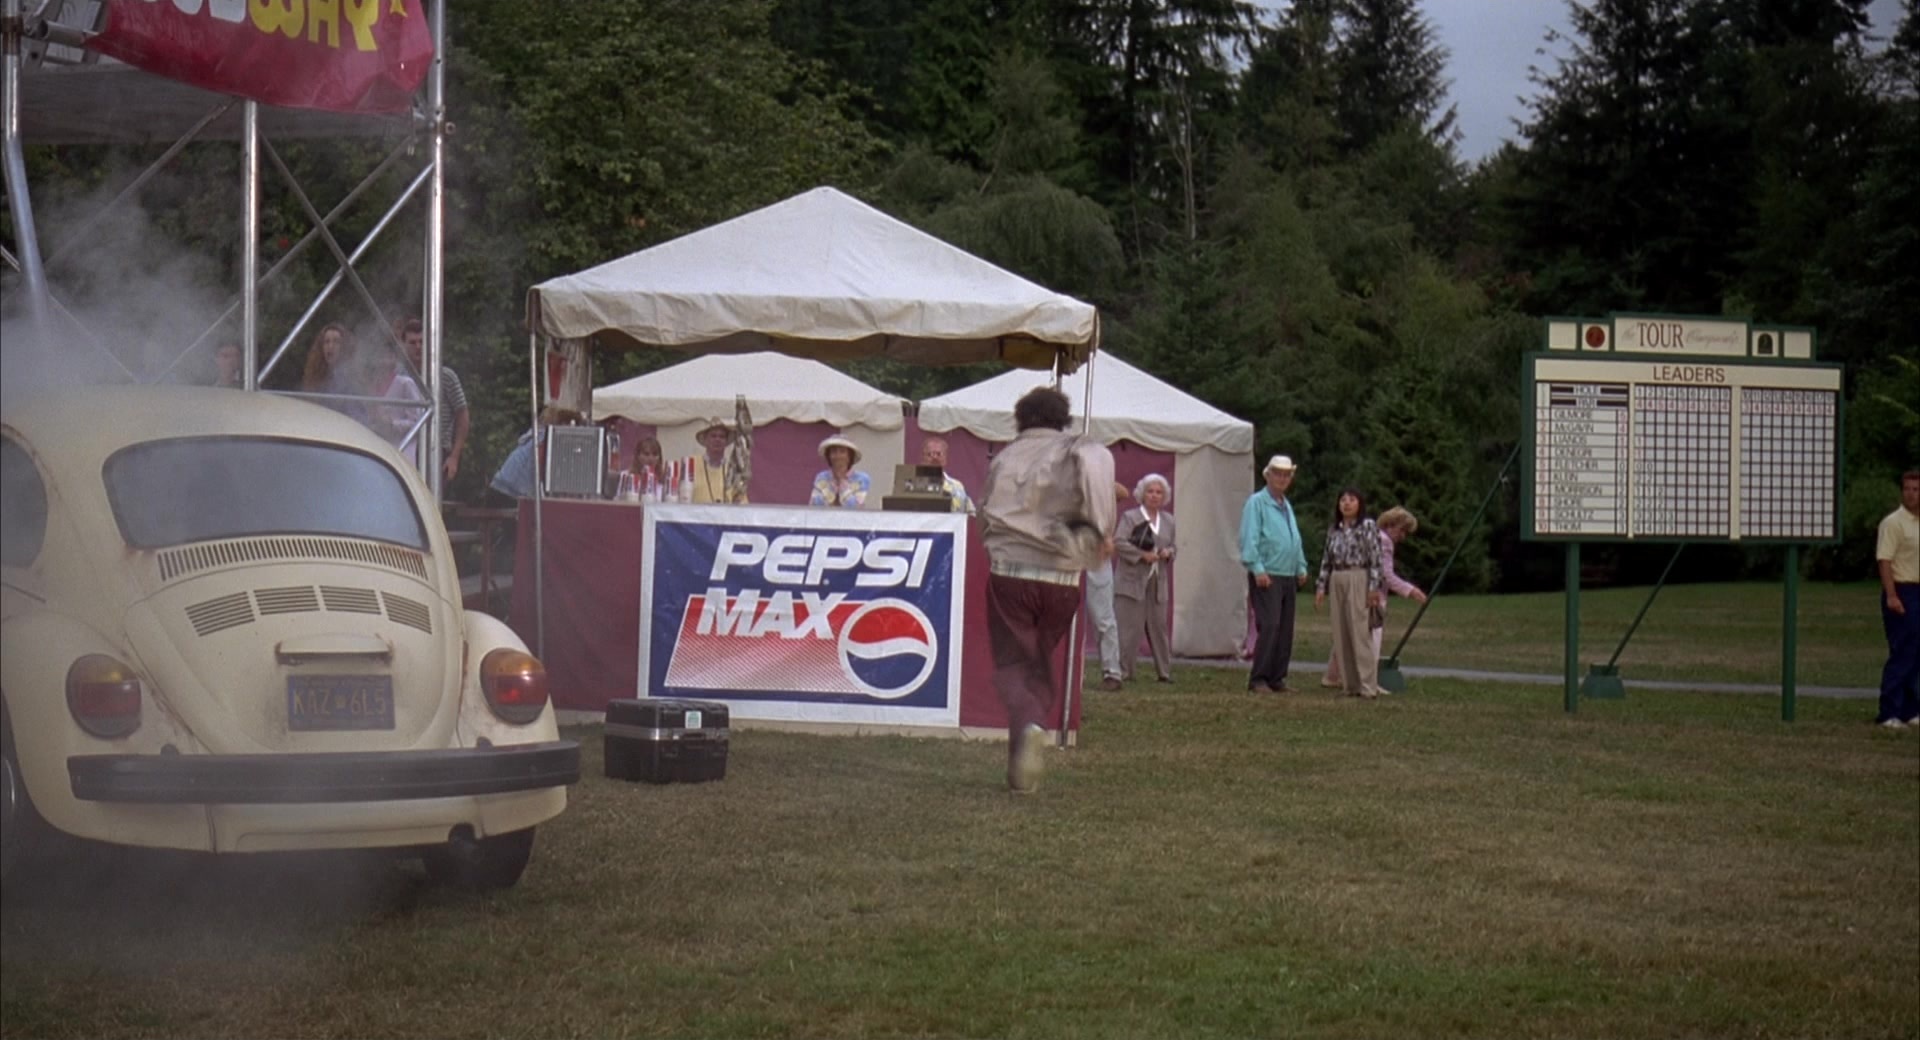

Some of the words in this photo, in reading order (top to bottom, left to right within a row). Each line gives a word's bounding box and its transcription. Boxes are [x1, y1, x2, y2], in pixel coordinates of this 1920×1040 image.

[1638, 322, 1684, 348] TOUR
[1653, 365, 1725, 383] LEADERS
[1574, 385, 1600, 396] HOLE
[709, 531, 934, 588] PEPSI
[697, 587, 848, 640] MAX
